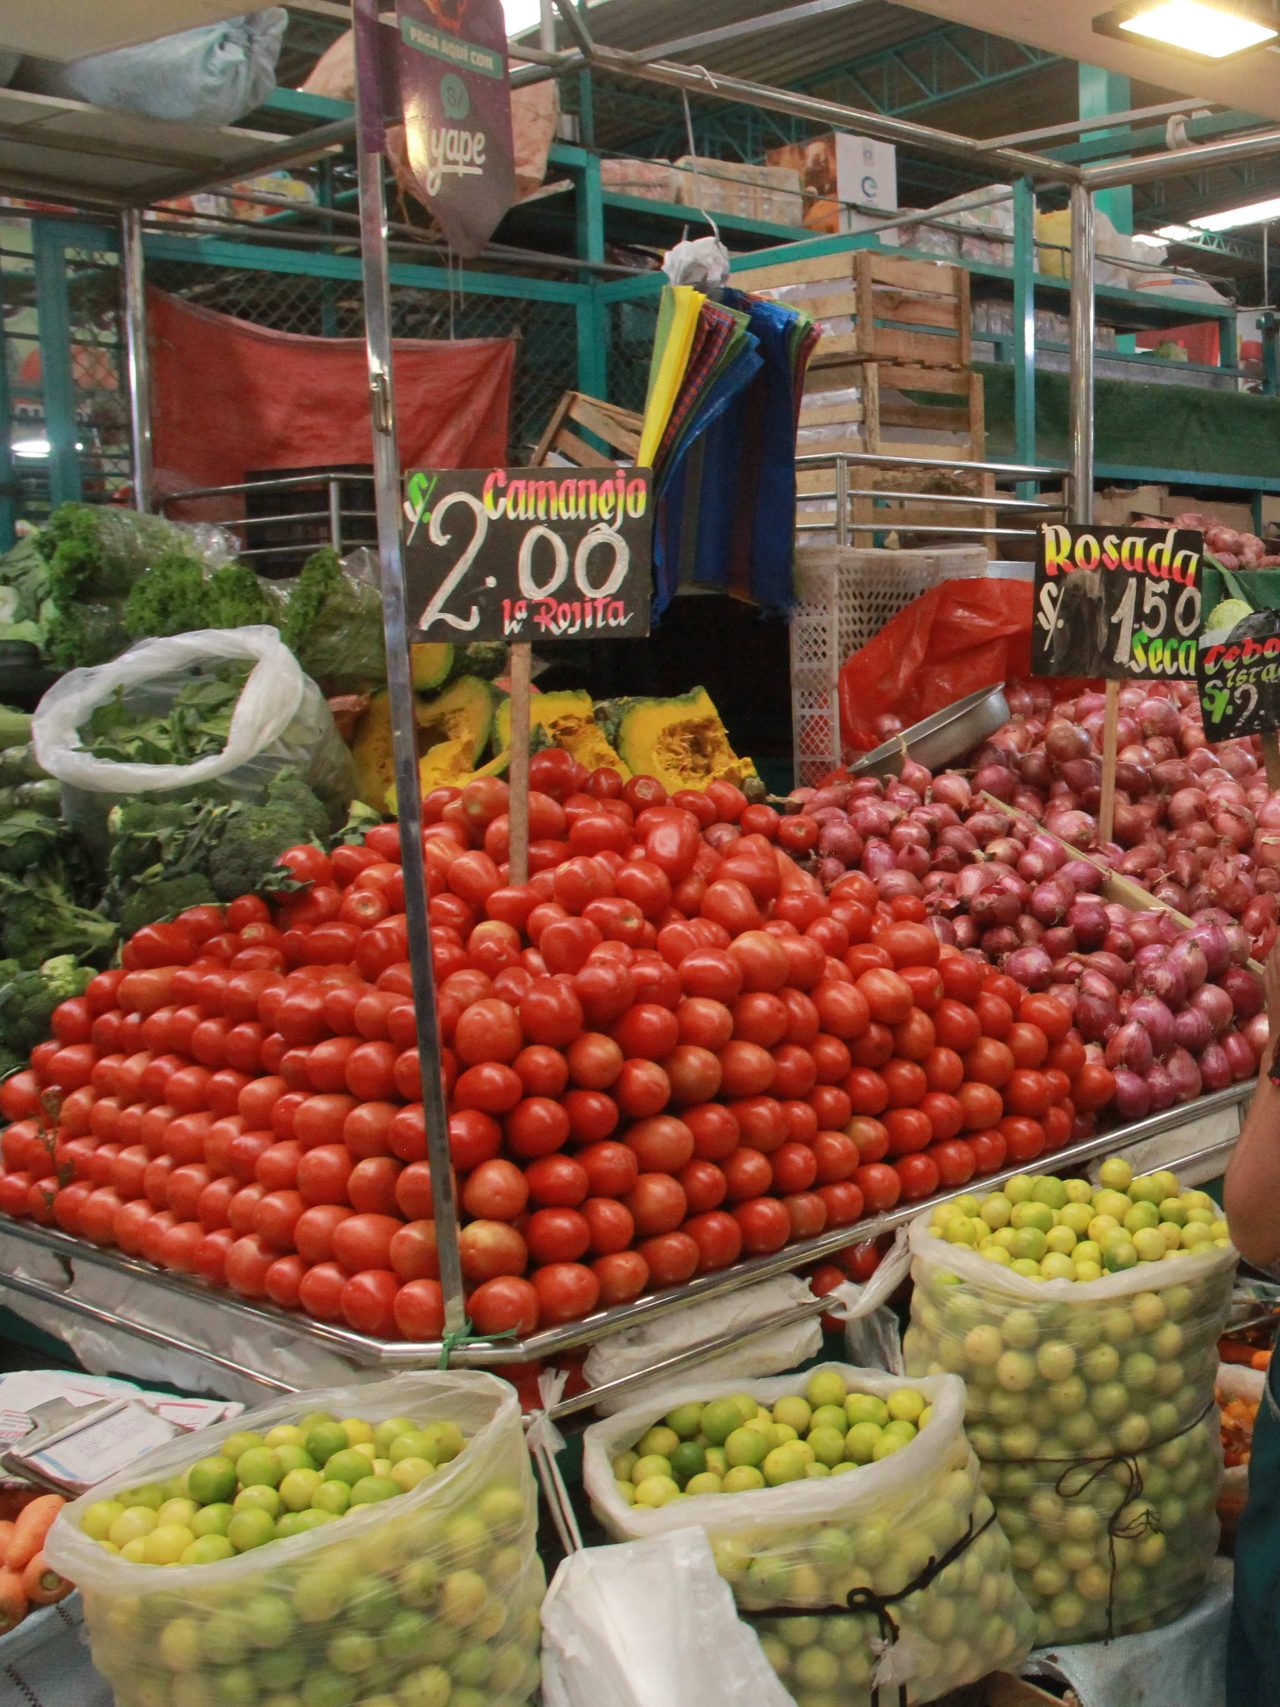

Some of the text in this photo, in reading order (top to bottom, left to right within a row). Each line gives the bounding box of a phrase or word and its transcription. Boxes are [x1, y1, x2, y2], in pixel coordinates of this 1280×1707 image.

[409, 26, 439, 51] PAGA
[469, 51, 494, 71] CON
[426, 128, 486, 197] yape
[483, 468, 647, 534] Camanejo
[419, 491, 630, 631] 2.00
[1041, 523, 1200, 587] Rosada
[1111, 577, 1202, 664] 1.50
[1125, 630, 1197, 676] Seca
